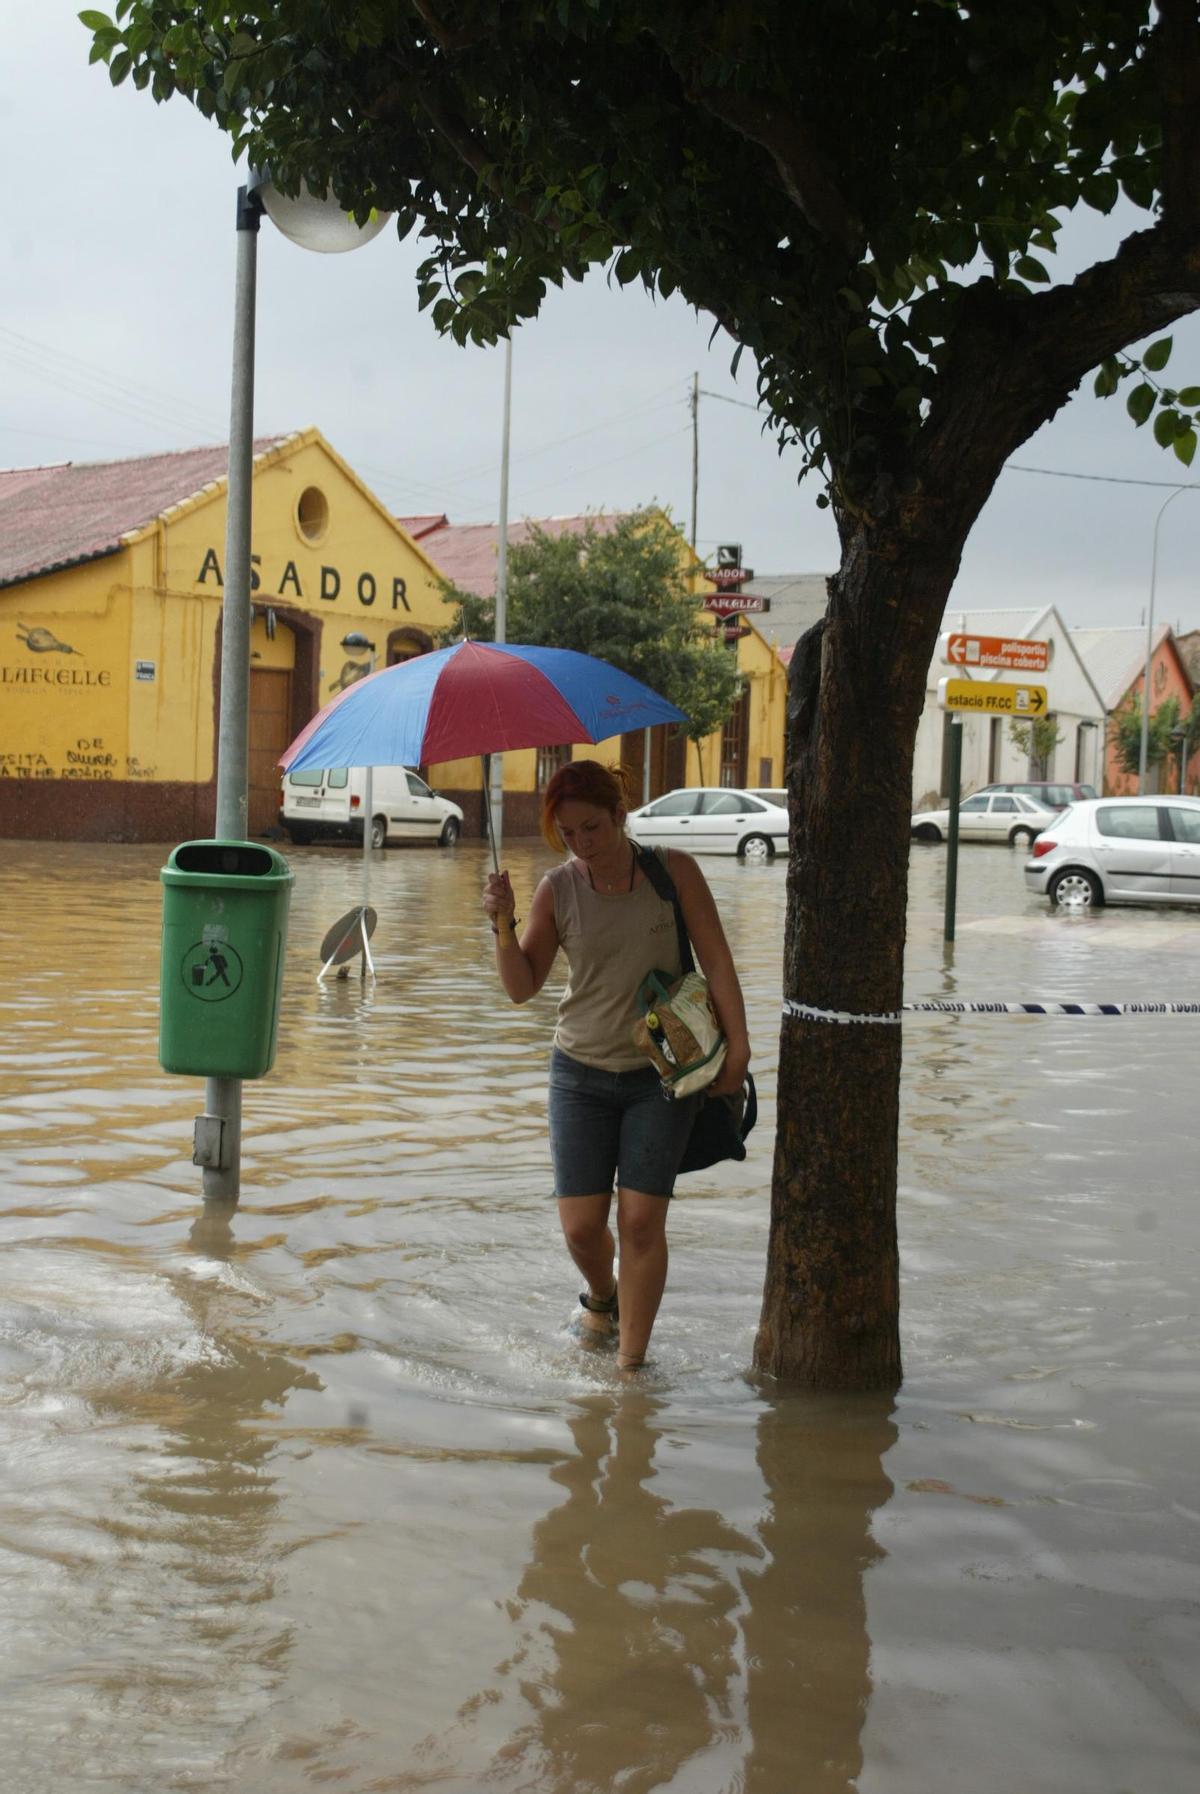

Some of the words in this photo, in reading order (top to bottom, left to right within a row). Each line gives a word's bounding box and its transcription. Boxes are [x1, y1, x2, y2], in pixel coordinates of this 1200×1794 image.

[980, 652, 1012, 667] piscina
[1013, 657, 1045, 669] coberta
[947, 693, 983, 706] estació
